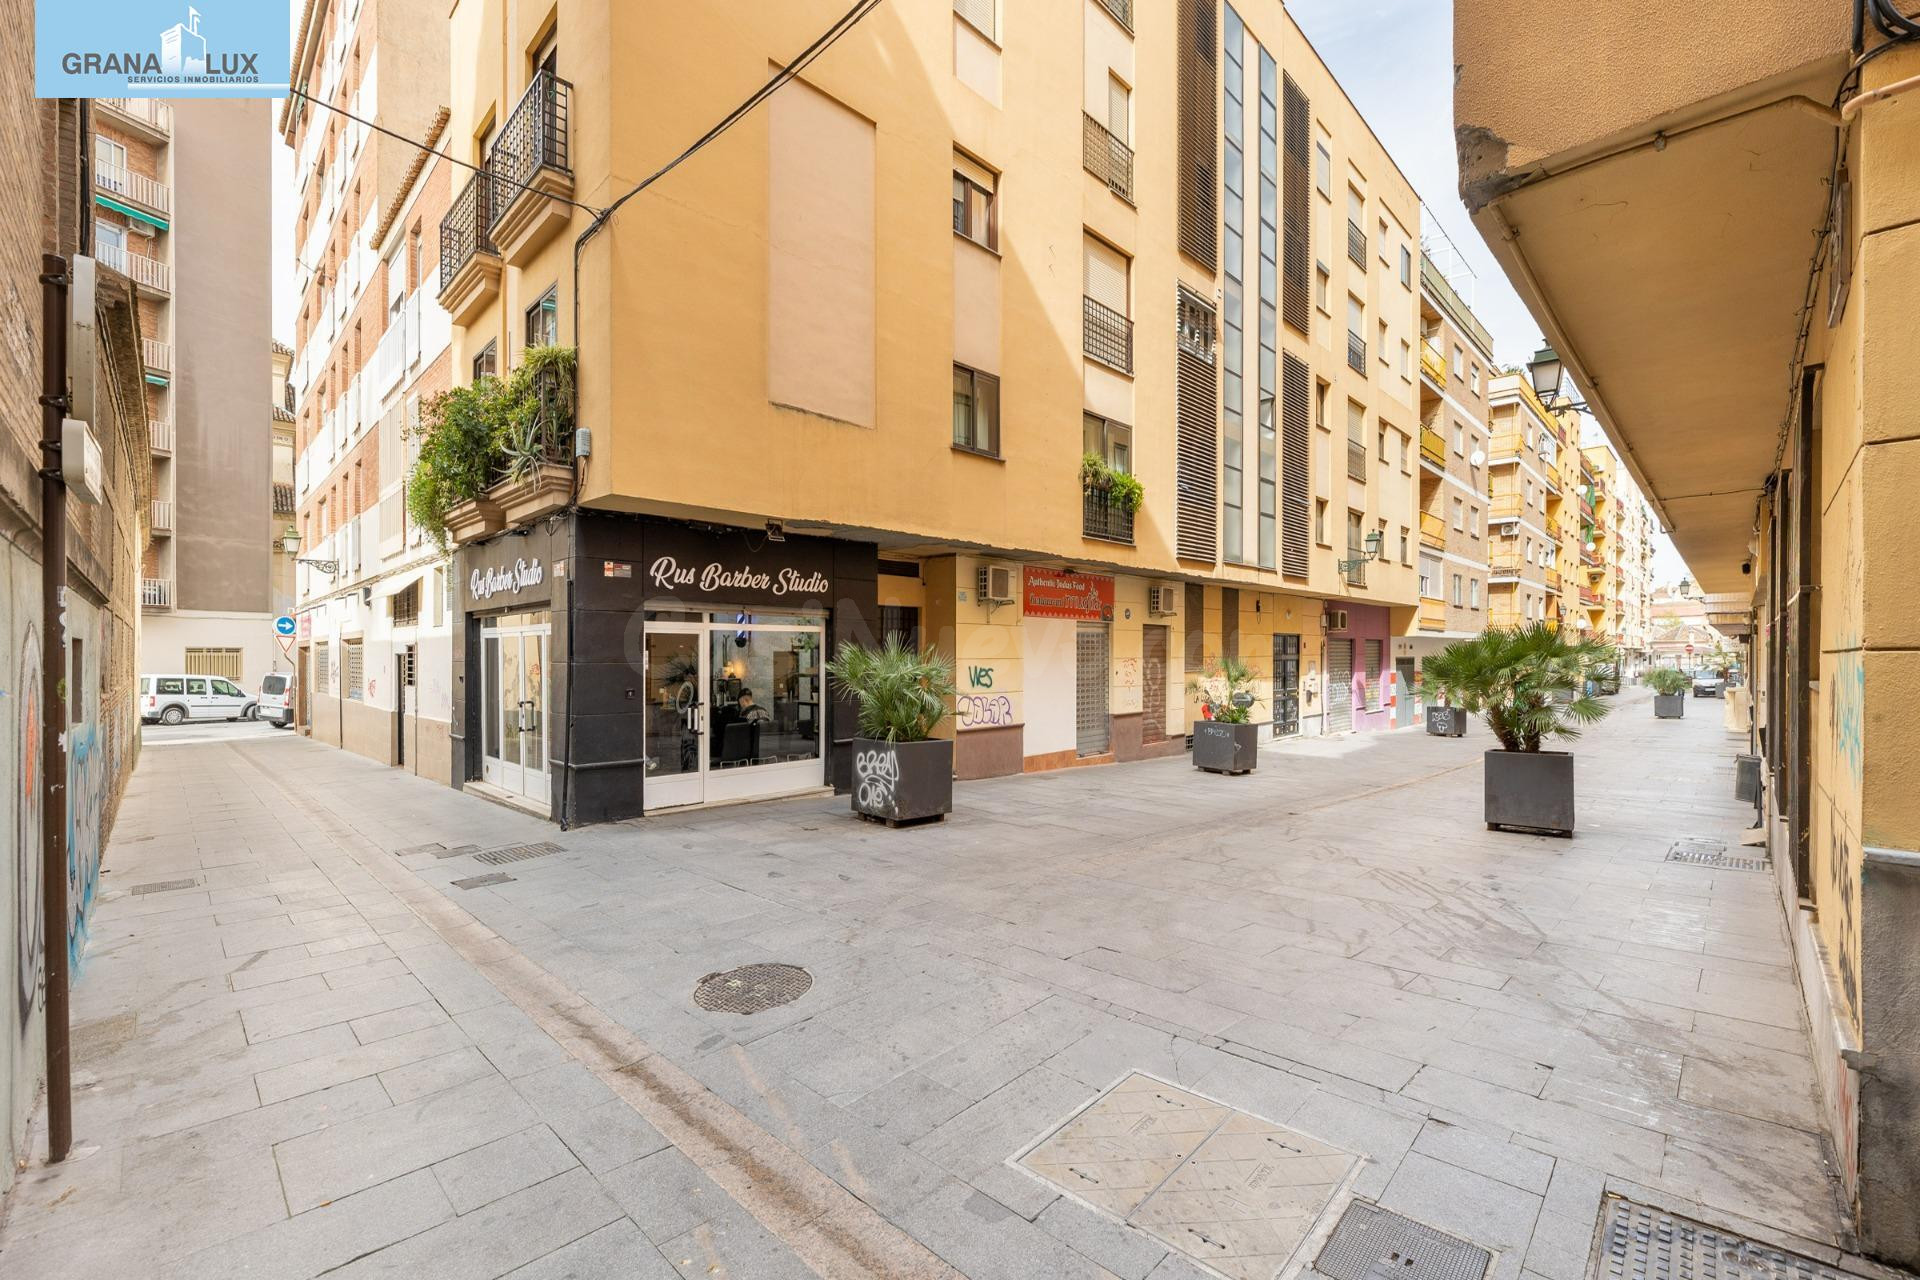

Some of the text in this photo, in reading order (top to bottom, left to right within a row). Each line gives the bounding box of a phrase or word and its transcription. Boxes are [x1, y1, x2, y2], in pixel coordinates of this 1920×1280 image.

[470, 568, 485, 600] Rus
[485, 565, 514, 599] Barber
[512, 557, 543, 594] Studio
[649, 556, 696, 590] Rus
[699, 562, 770, 592] Barber
[772, 567, 829, 596] Studio
